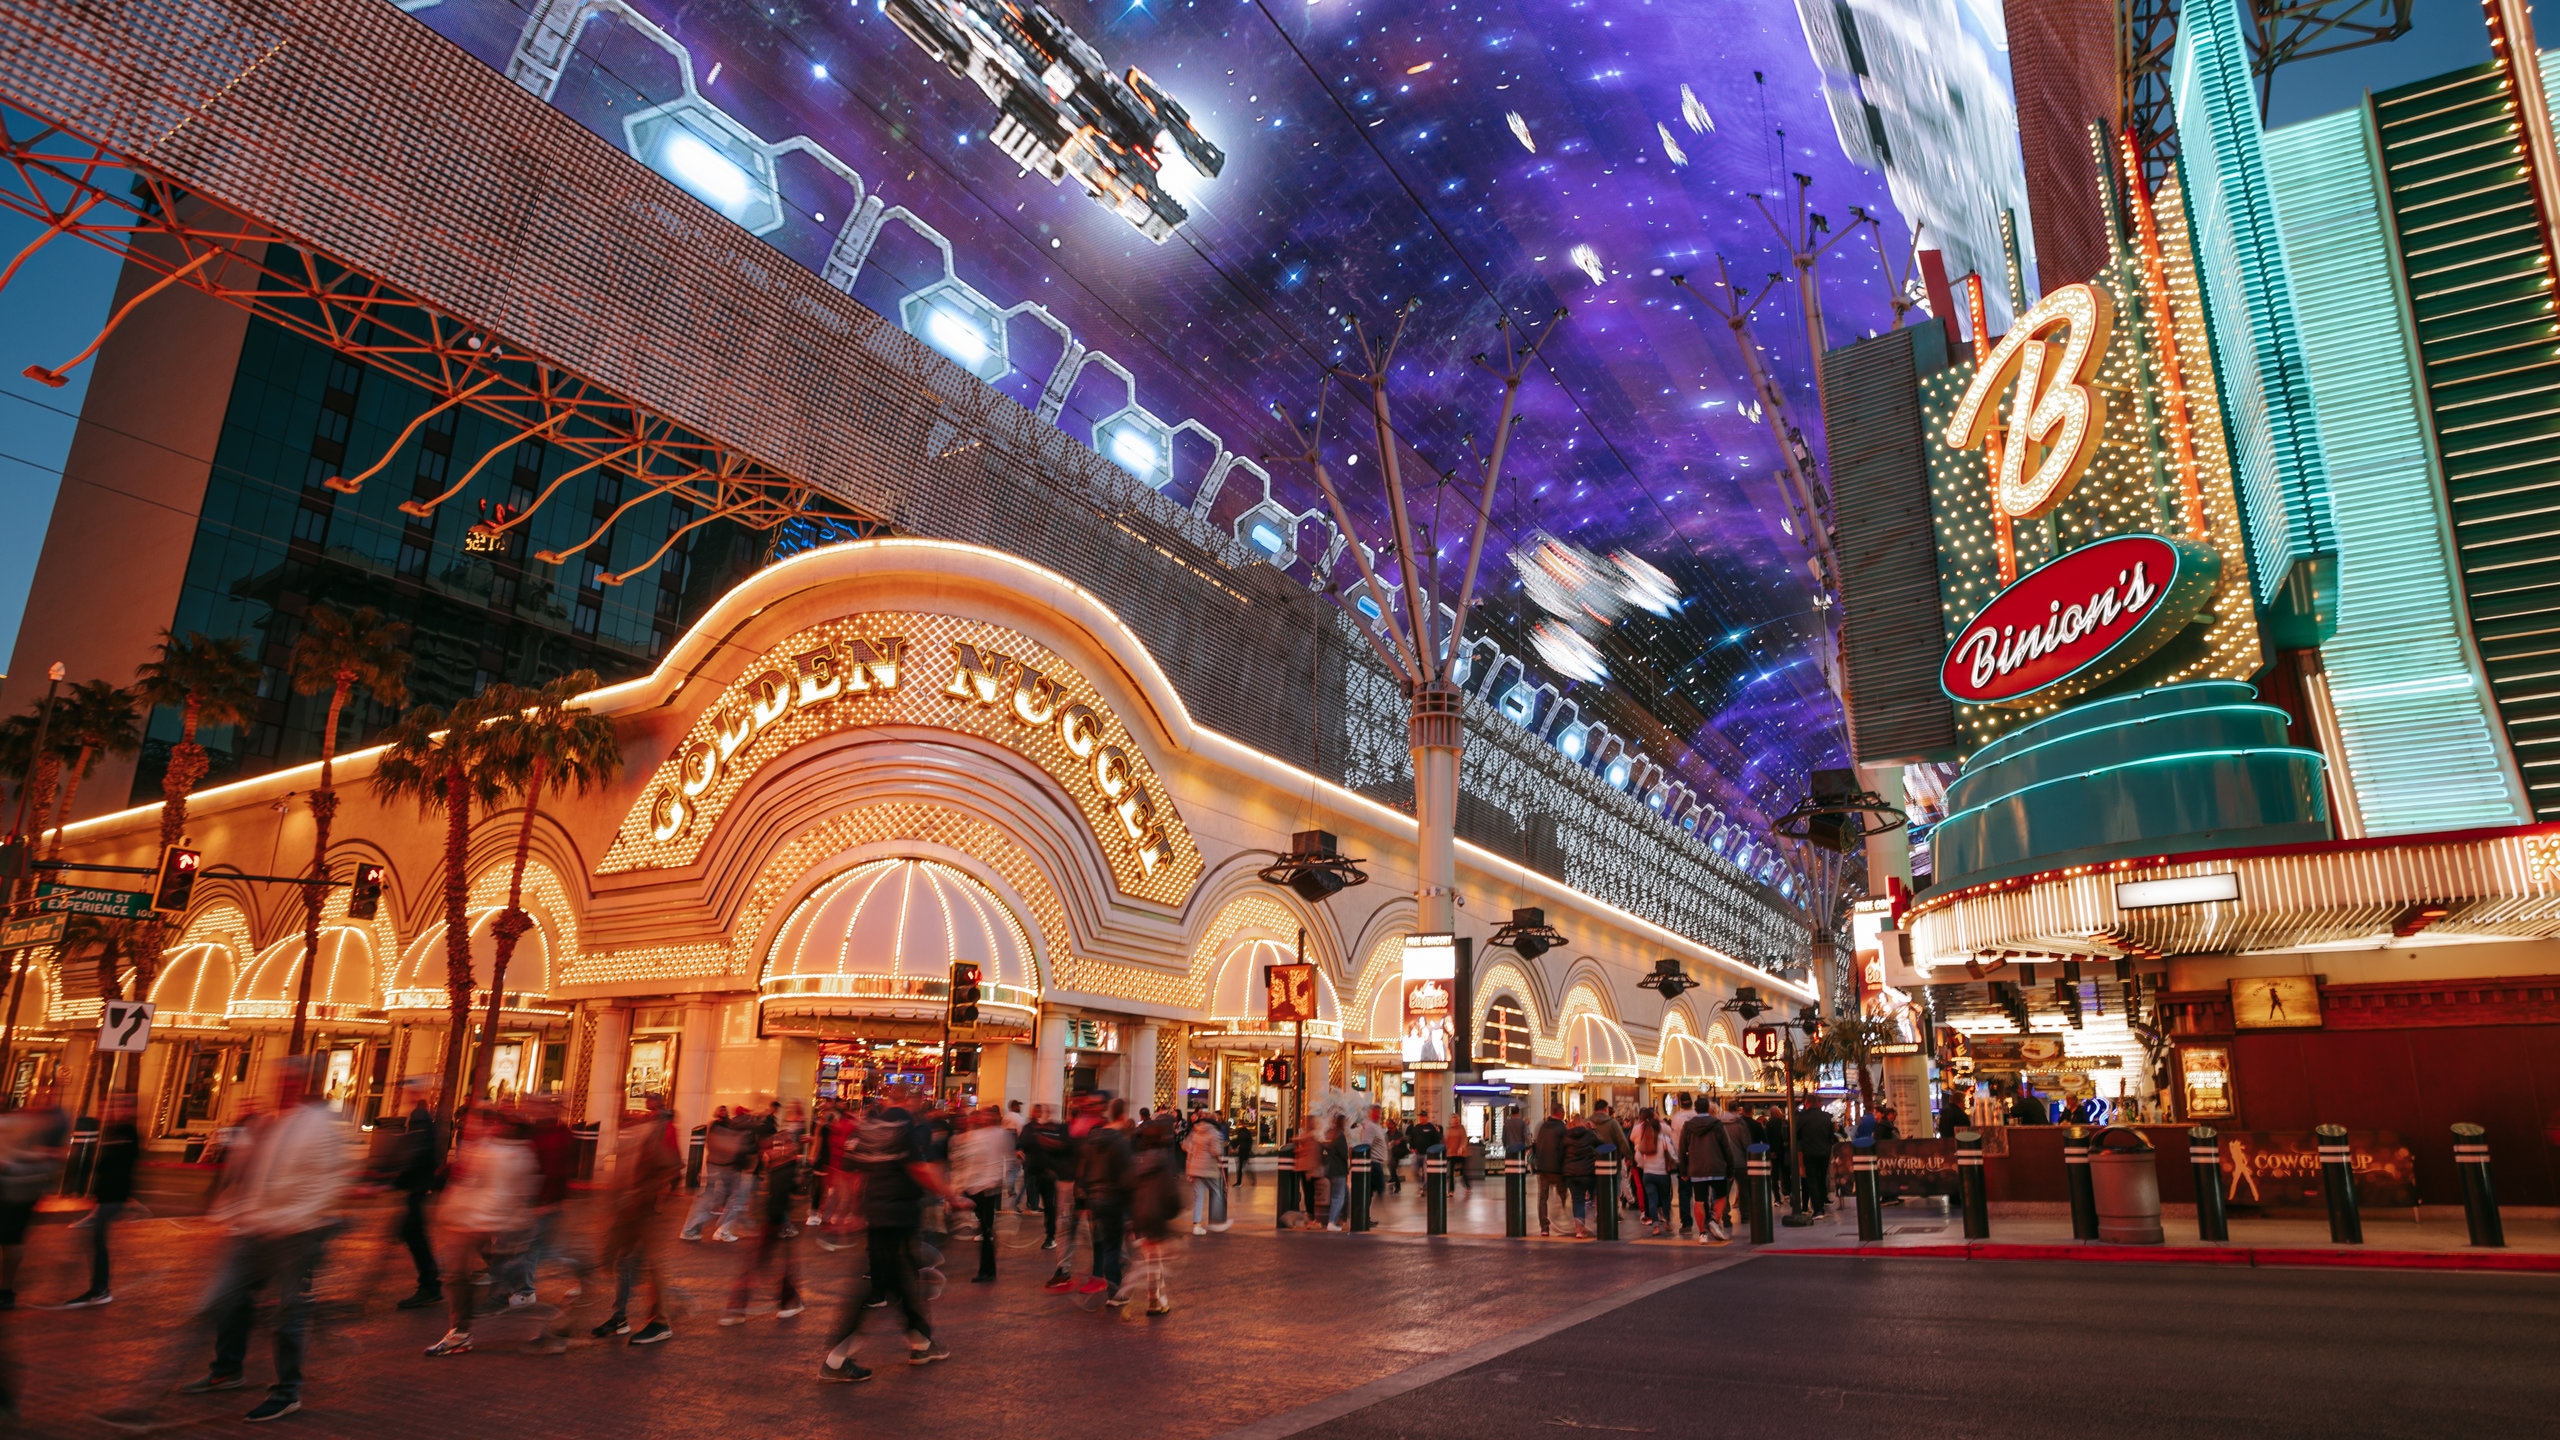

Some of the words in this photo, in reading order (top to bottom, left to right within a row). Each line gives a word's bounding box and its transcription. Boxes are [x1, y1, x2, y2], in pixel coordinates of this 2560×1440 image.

[1946, 282, 2099, 517] B
[1956, 560, 2156, 690] Binion's
[649, 635, 906, 842] GOLDEN
[943, 640, 1176, 879] NUGGET
[115, 894, 132, 904] ST
[1854, 900, 1874, 912] FREE
[47, 898, 129, 916] EXPERIENCE
[1405, 936, 1421, 947] FREE
[1421, 935, 1453, 946] CONCERT
[1876, 1157, 1926, 1170] OWGIRL
